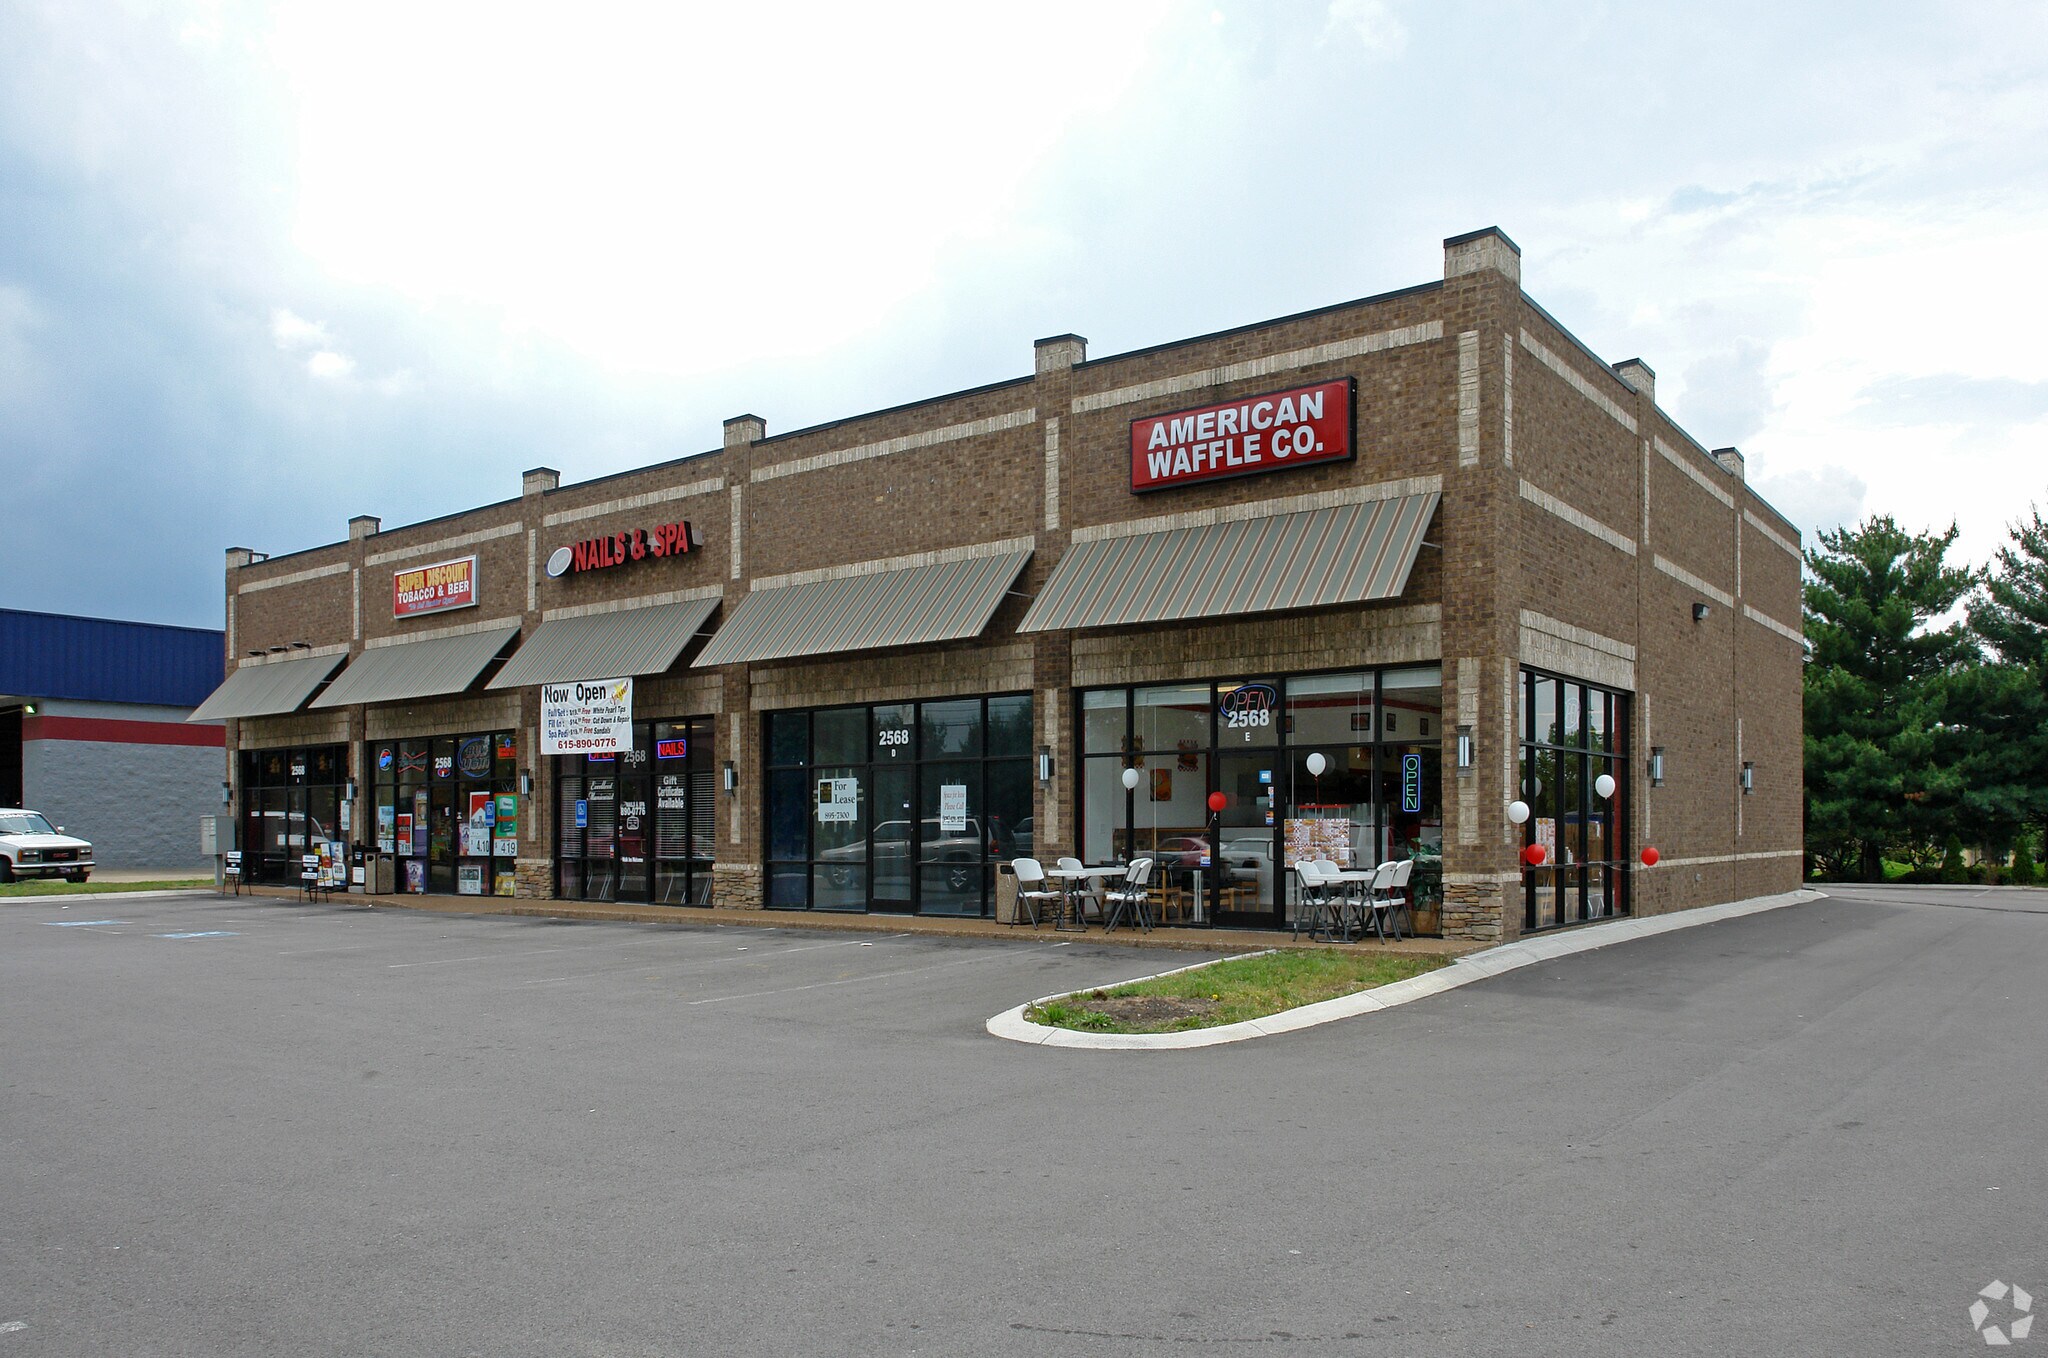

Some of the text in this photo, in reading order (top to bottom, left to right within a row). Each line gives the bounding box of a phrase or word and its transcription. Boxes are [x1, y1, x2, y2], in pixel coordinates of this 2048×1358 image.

[1148, 391, 1324, 450] AMERICAN
[1147, 425, 1324, 480] WAFFLE CO.
[575, 530, 626, 572] NAILS
[631, 528, 645, 560] &
[653, 521, 689, 558] SPA
[398, 562, 468, 593] SUPER DISCOUNT
[397, 586, 435, 604] TOBACCO
[437, 585, 444, 597] &
[447, 580, 469, 595] BEER
[544, 685, 569, 704] Now
[575, 682, 607, 705] Open
[1222, 691, 1272, 712] OPEN
[592, 706, 604, 714] White
[604, 706, 617, 714] Pearl
[617, 705, 626, 714] Tips
[1228, 709, 1269, 728] 2568
[557, 737, 617, 749] 615-890-0776
[879, 729, 909, 746] 2568
[1245, 732, 1251, 741] E
[659, 741, 685, 756] NAILS
[891, 749, 896, 757] D
[435, 756, 452, 769] 2568
[623, 750, 646, 763] 2568
[663, 775, 677, 785] Gift
[834, 780, 847, 791] For
[1405, 757, 1418, 809] OPEN
[657, 786, 684, 797] Certificates
[657, 797, 684, 809] Available
[834, 794, 856, 804] Lease
[824, 811, 850, 820] 895-7300
